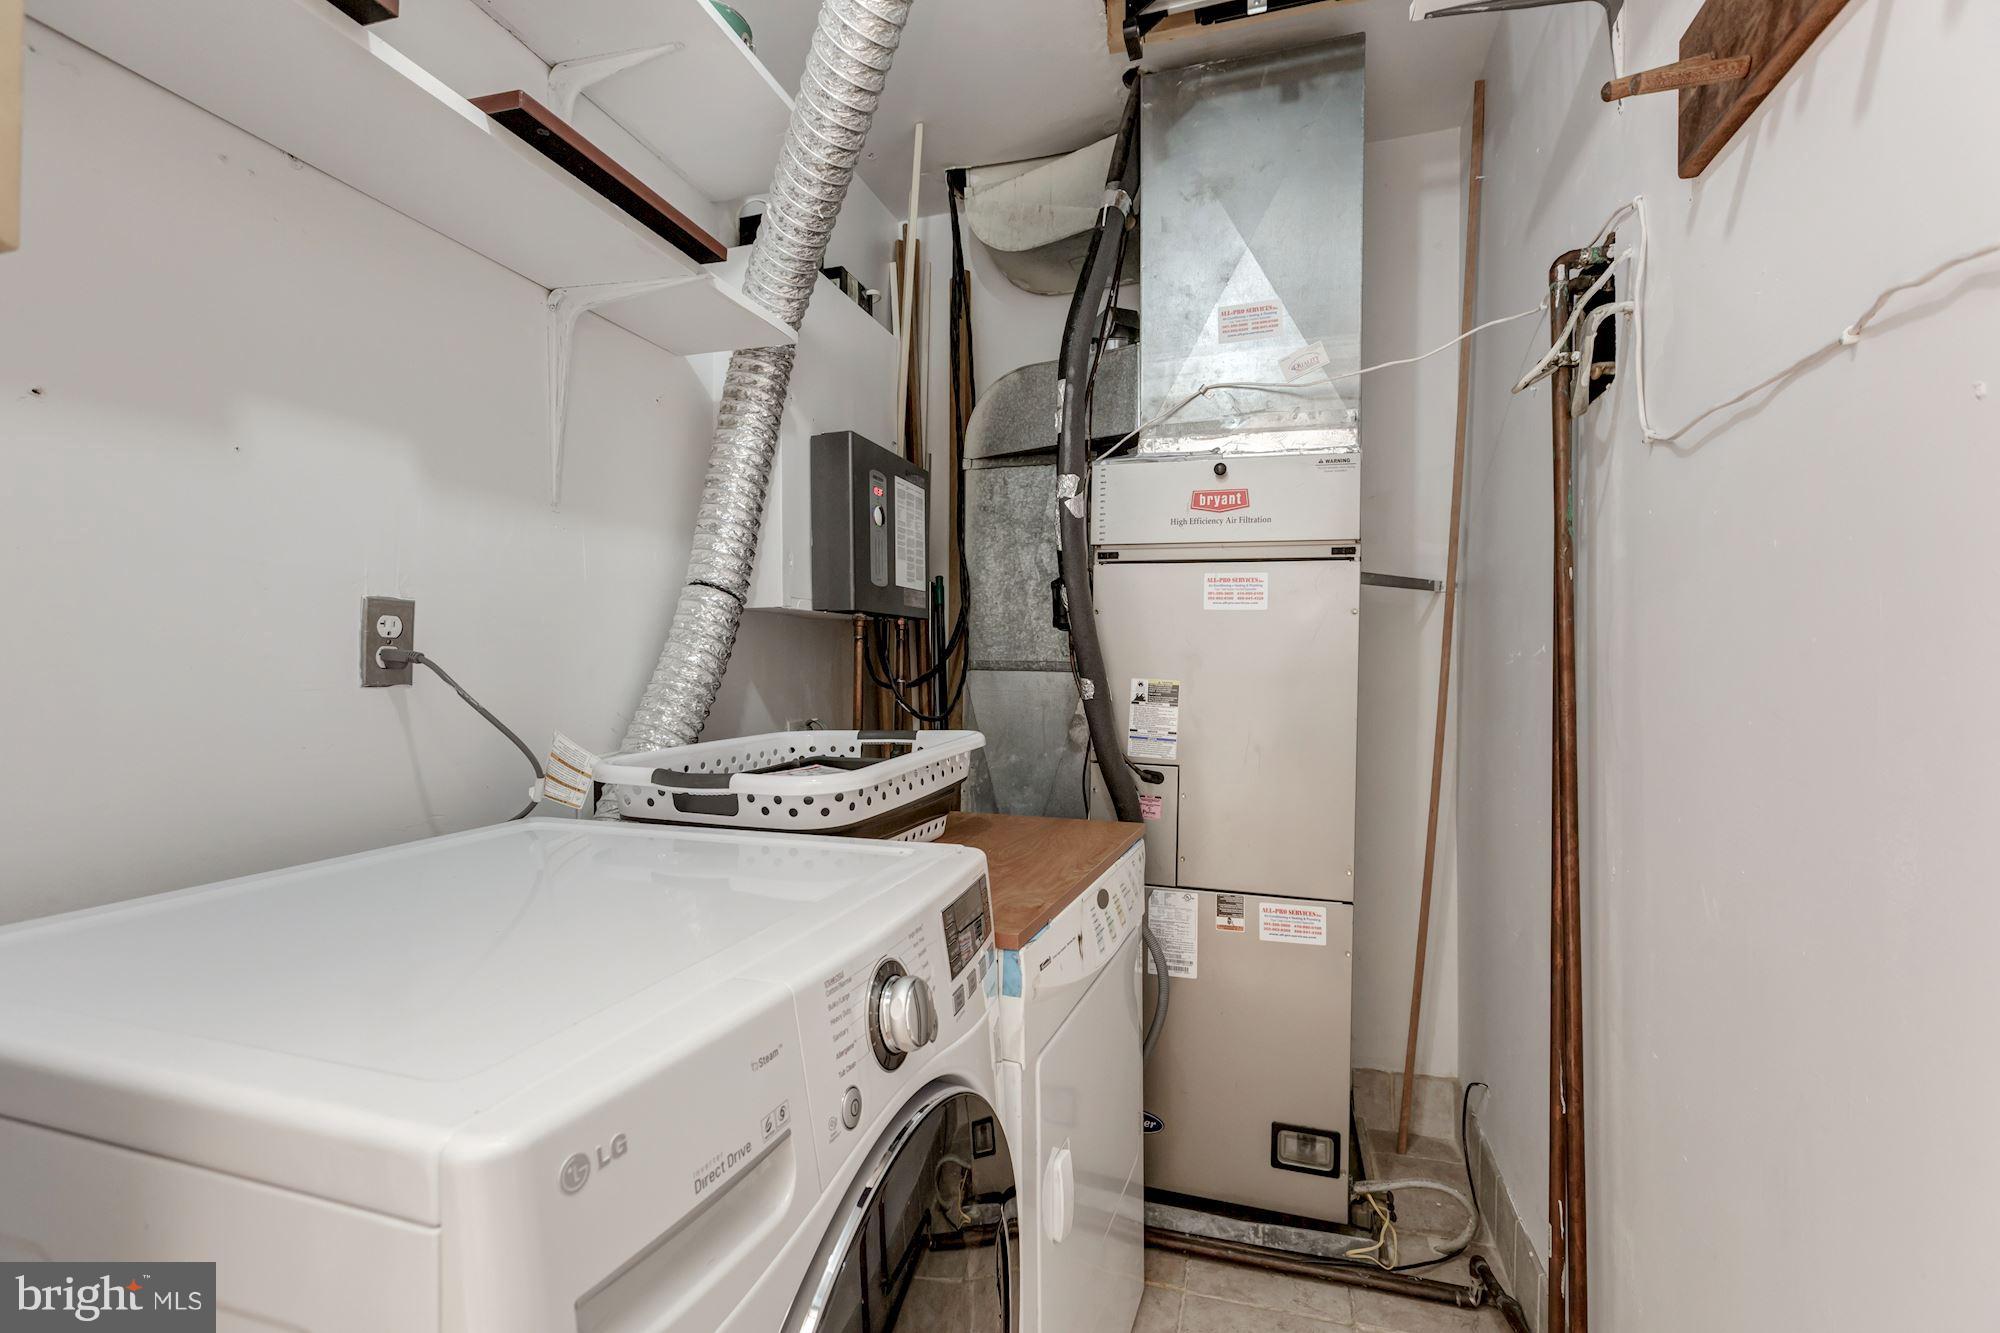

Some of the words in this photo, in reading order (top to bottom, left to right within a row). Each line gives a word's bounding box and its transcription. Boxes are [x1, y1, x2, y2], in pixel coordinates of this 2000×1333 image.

[1199, 492, 1242, 508] bryant
[1170, 517, 1188, 527] High
[1189, 516, 1224, 527] Efficiency
[1225, 516, 1238, 524] Air
[1238, 515, 1272, 524] Filtration
[1262, 907, 1287, 915] ALL-PRO
[1288, 909, 1316, 917] SERVICES
[596, 1133, 629, 1171] LG
[694, 1162, 725, 1195] Direct
[727, 1142, 752, 1169] Drive
